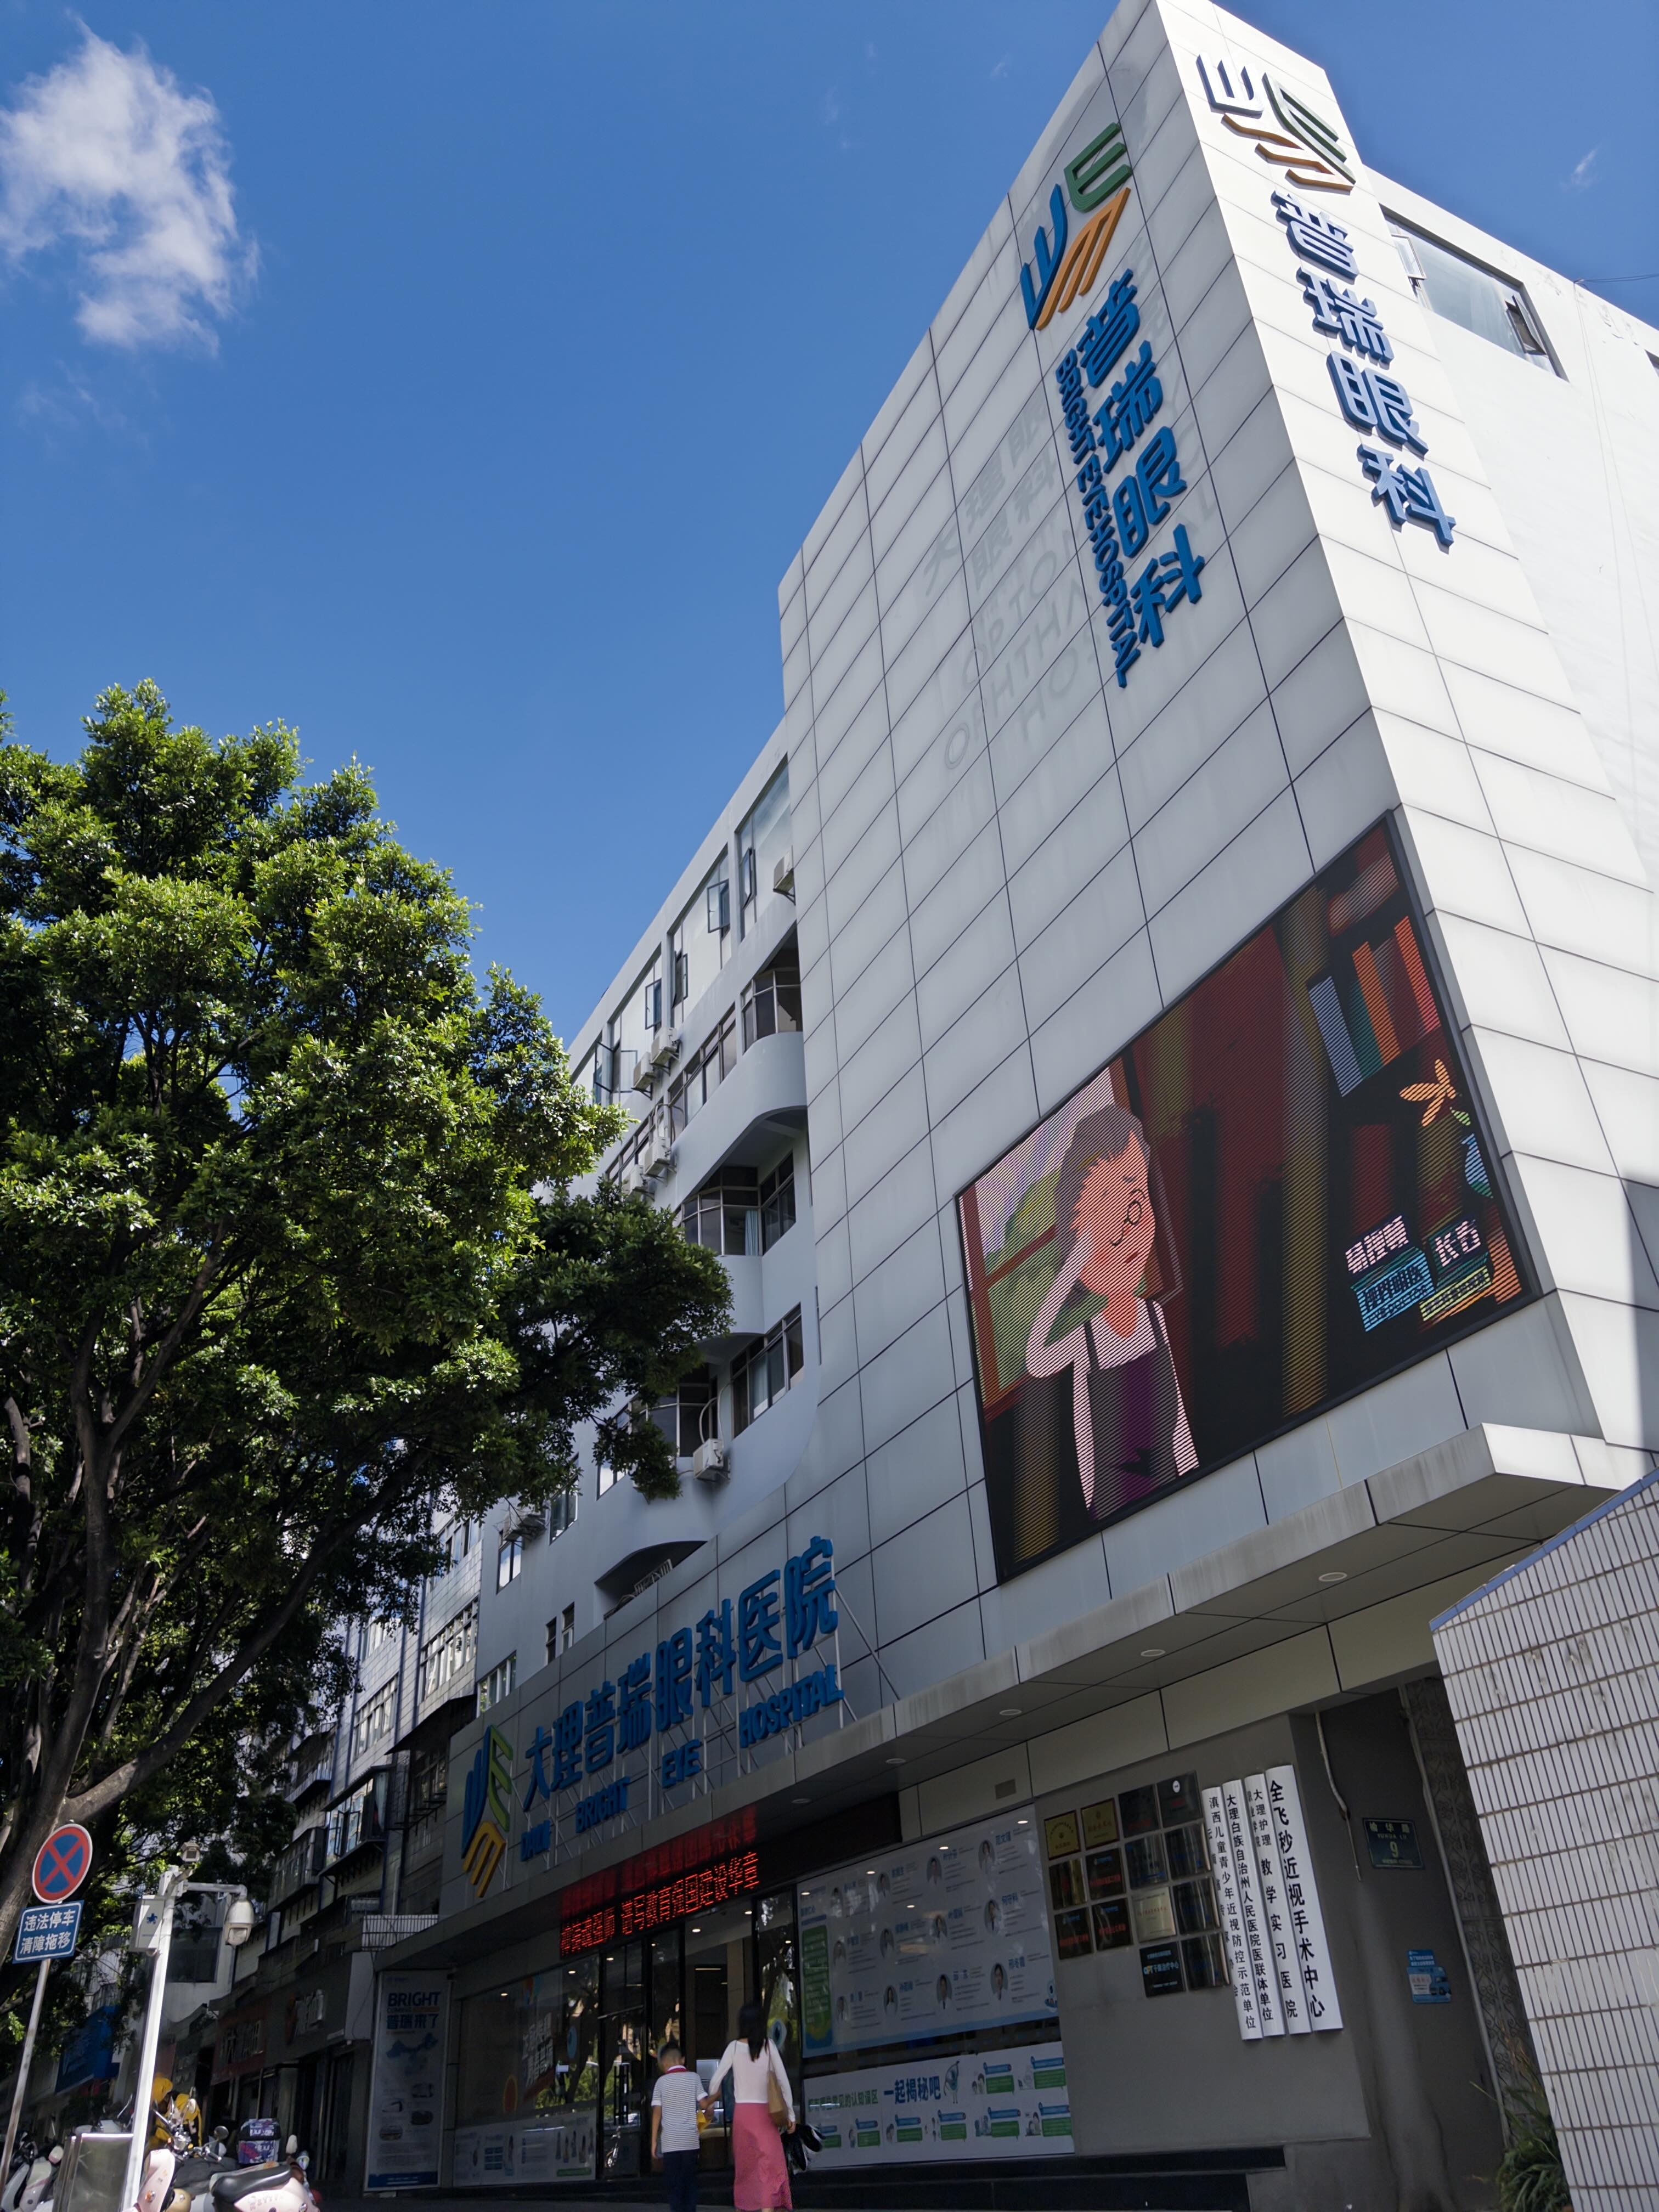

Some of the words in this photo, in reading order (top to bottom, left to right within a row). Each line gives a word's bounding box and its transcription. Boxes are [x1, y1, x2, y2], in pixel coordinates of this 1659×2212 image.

[1055, 348, 1097, 465] BRIGHT
[1271, 190, 1457, 548] 普瑞眼科
[1077, 268, 1205, 648] 普瑞眼科
[1077, 453, 1110, 531] EYE
[1089, 513, 1142, 689] HOSPITAL
[523, 1536, 839, 1812] 大理普瑞眼科医院
[576, 1776, 630, 1833] BRIGHT
[662, 1739, 702, 1789] EYE
[740, 1664, 845, 1748] HOSPITAL
[24, 1909, 76, 1932] 违法停车
[1209, 1796, 1256, 2029] 滇西儿童青少年近视防控示范单位
[1226, 1795, 1274, 2021] 大理白族自治州人民医院医联体单位
[1269, 1780, 1325, 2018] 全飞秒近视手术中心
[1390, 1841, 1399, 1858] 9
[20, 1931, 71, 1955] 清障拖移
[388, 1991, 441, 2007] BRIGHT
[1261, 1858, 1299, 2018] 教学实习医院
[387, 2013, 438, 2029] 普瑞来了
[884, 2075, 941, 2104] 一起揭秘吧
